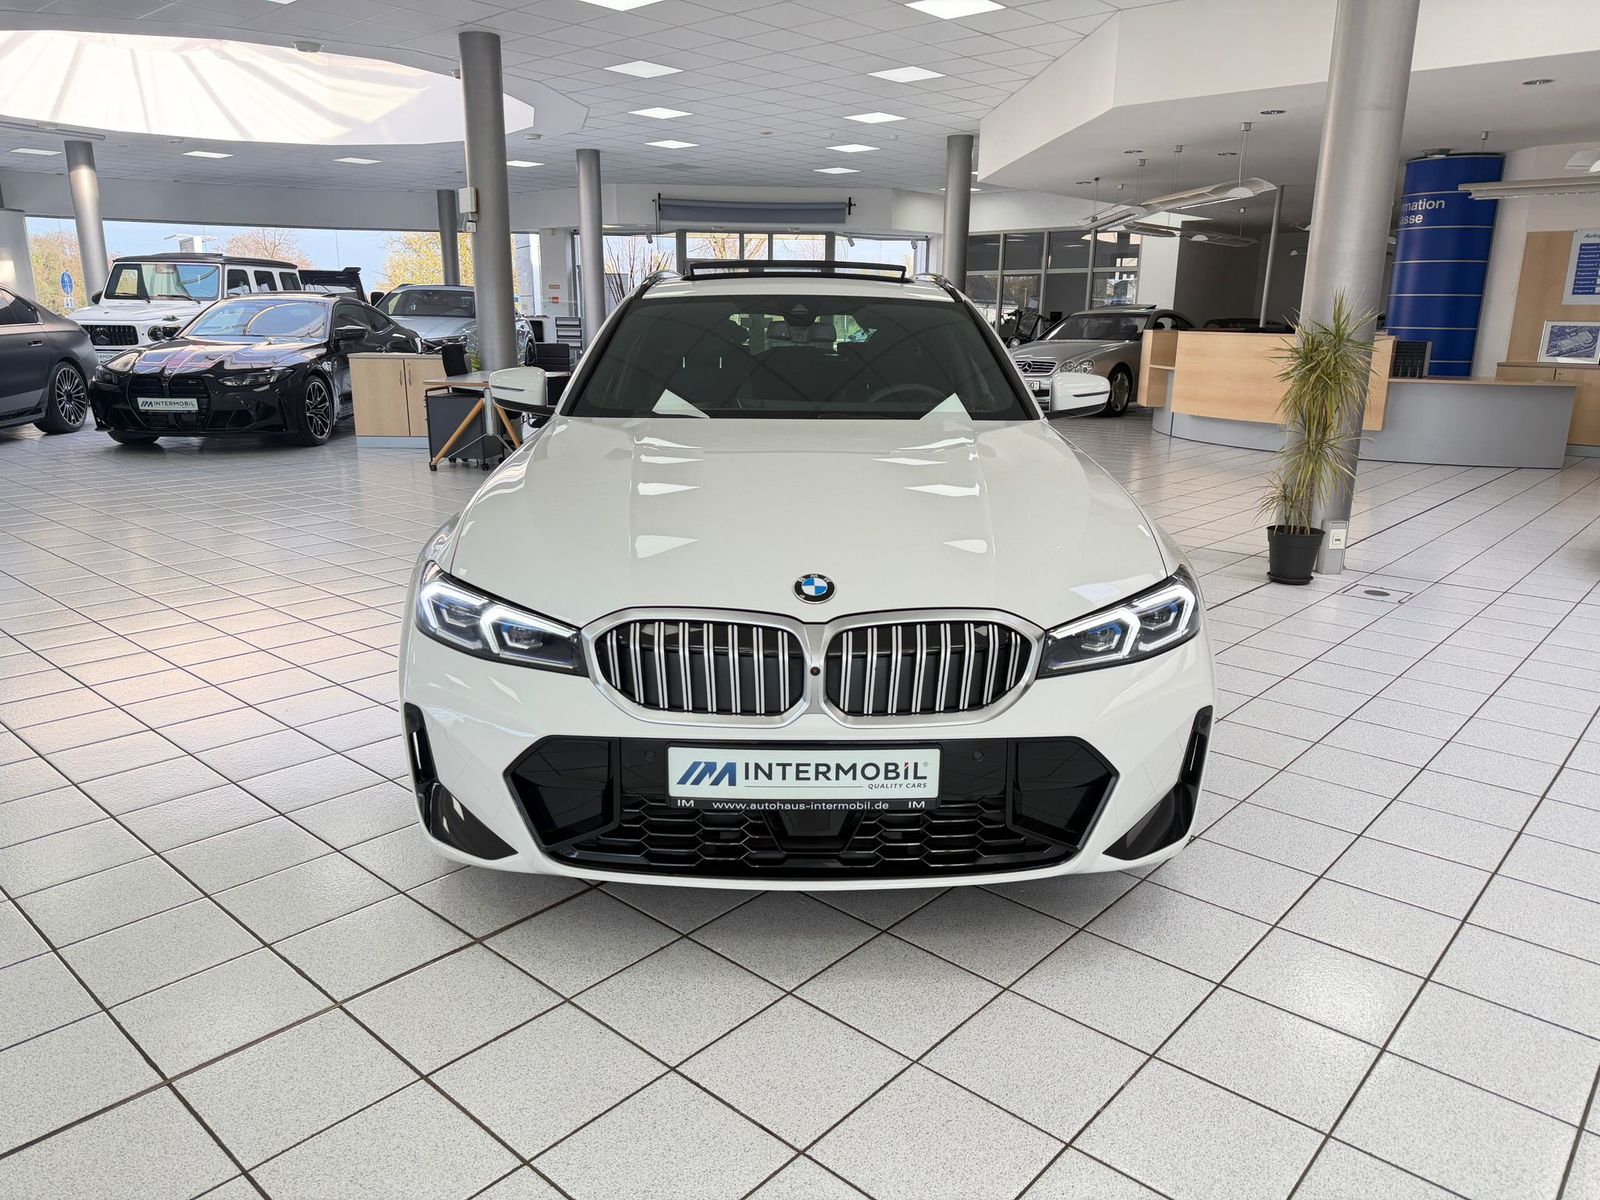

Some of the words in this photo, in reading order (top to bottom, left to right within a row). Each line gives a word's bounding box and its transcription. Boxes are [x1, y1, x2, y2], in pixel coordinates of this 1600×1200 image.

[677, 799, 695, 807] IM
[712, 801, 889, 810] www.autohaus-intermobil.de
[908, 801, 926, 809] IM
